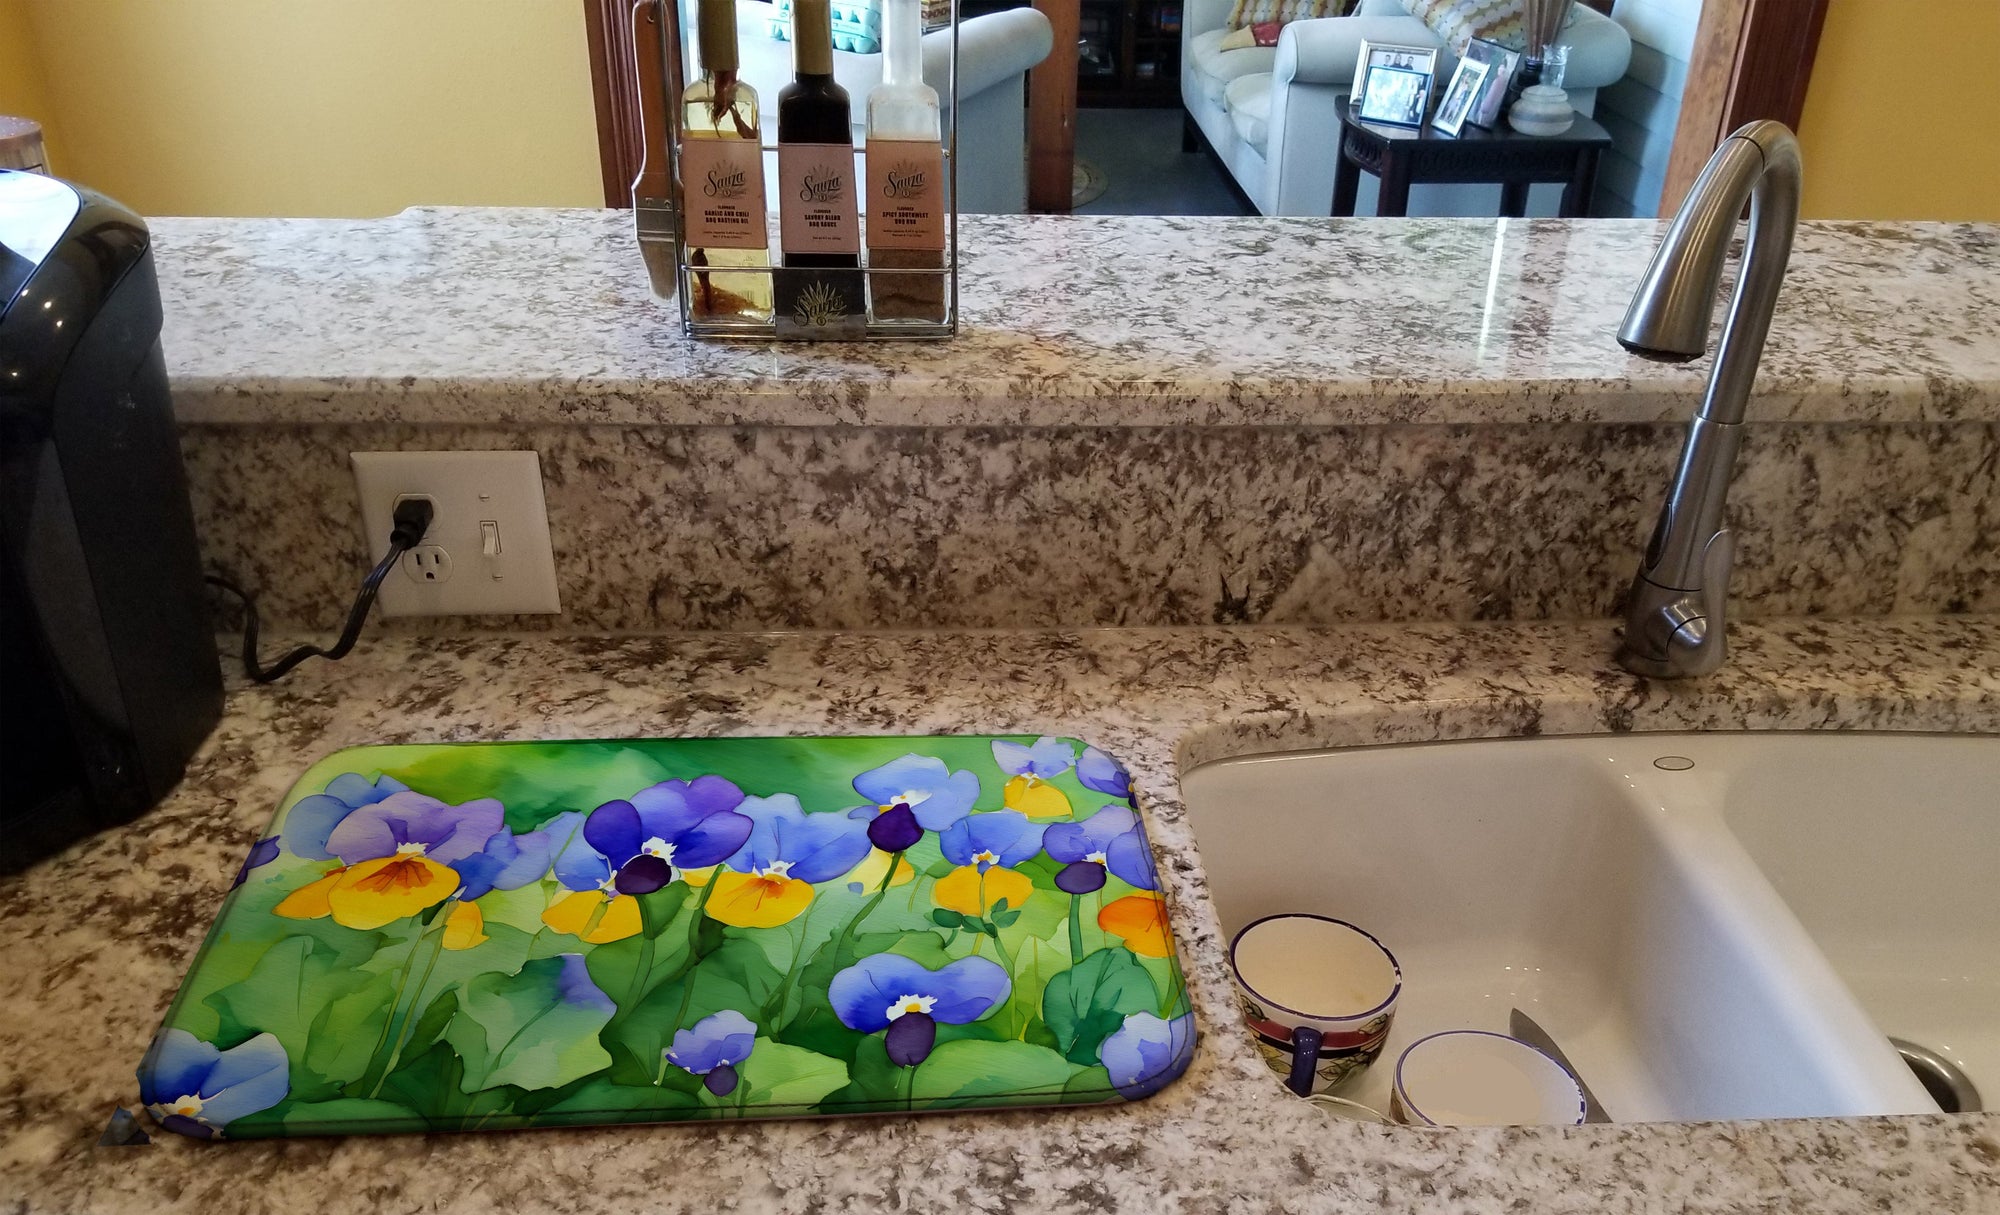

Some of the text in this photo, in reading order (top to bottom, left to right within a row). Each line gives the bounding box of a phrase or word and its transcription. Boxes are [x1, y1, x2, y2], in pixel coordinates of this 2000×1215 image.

[703, 170, 745, 197] Sauza
[800, 175, 841, 202] Sauza
[884, 171, 924, 198] Sauza
